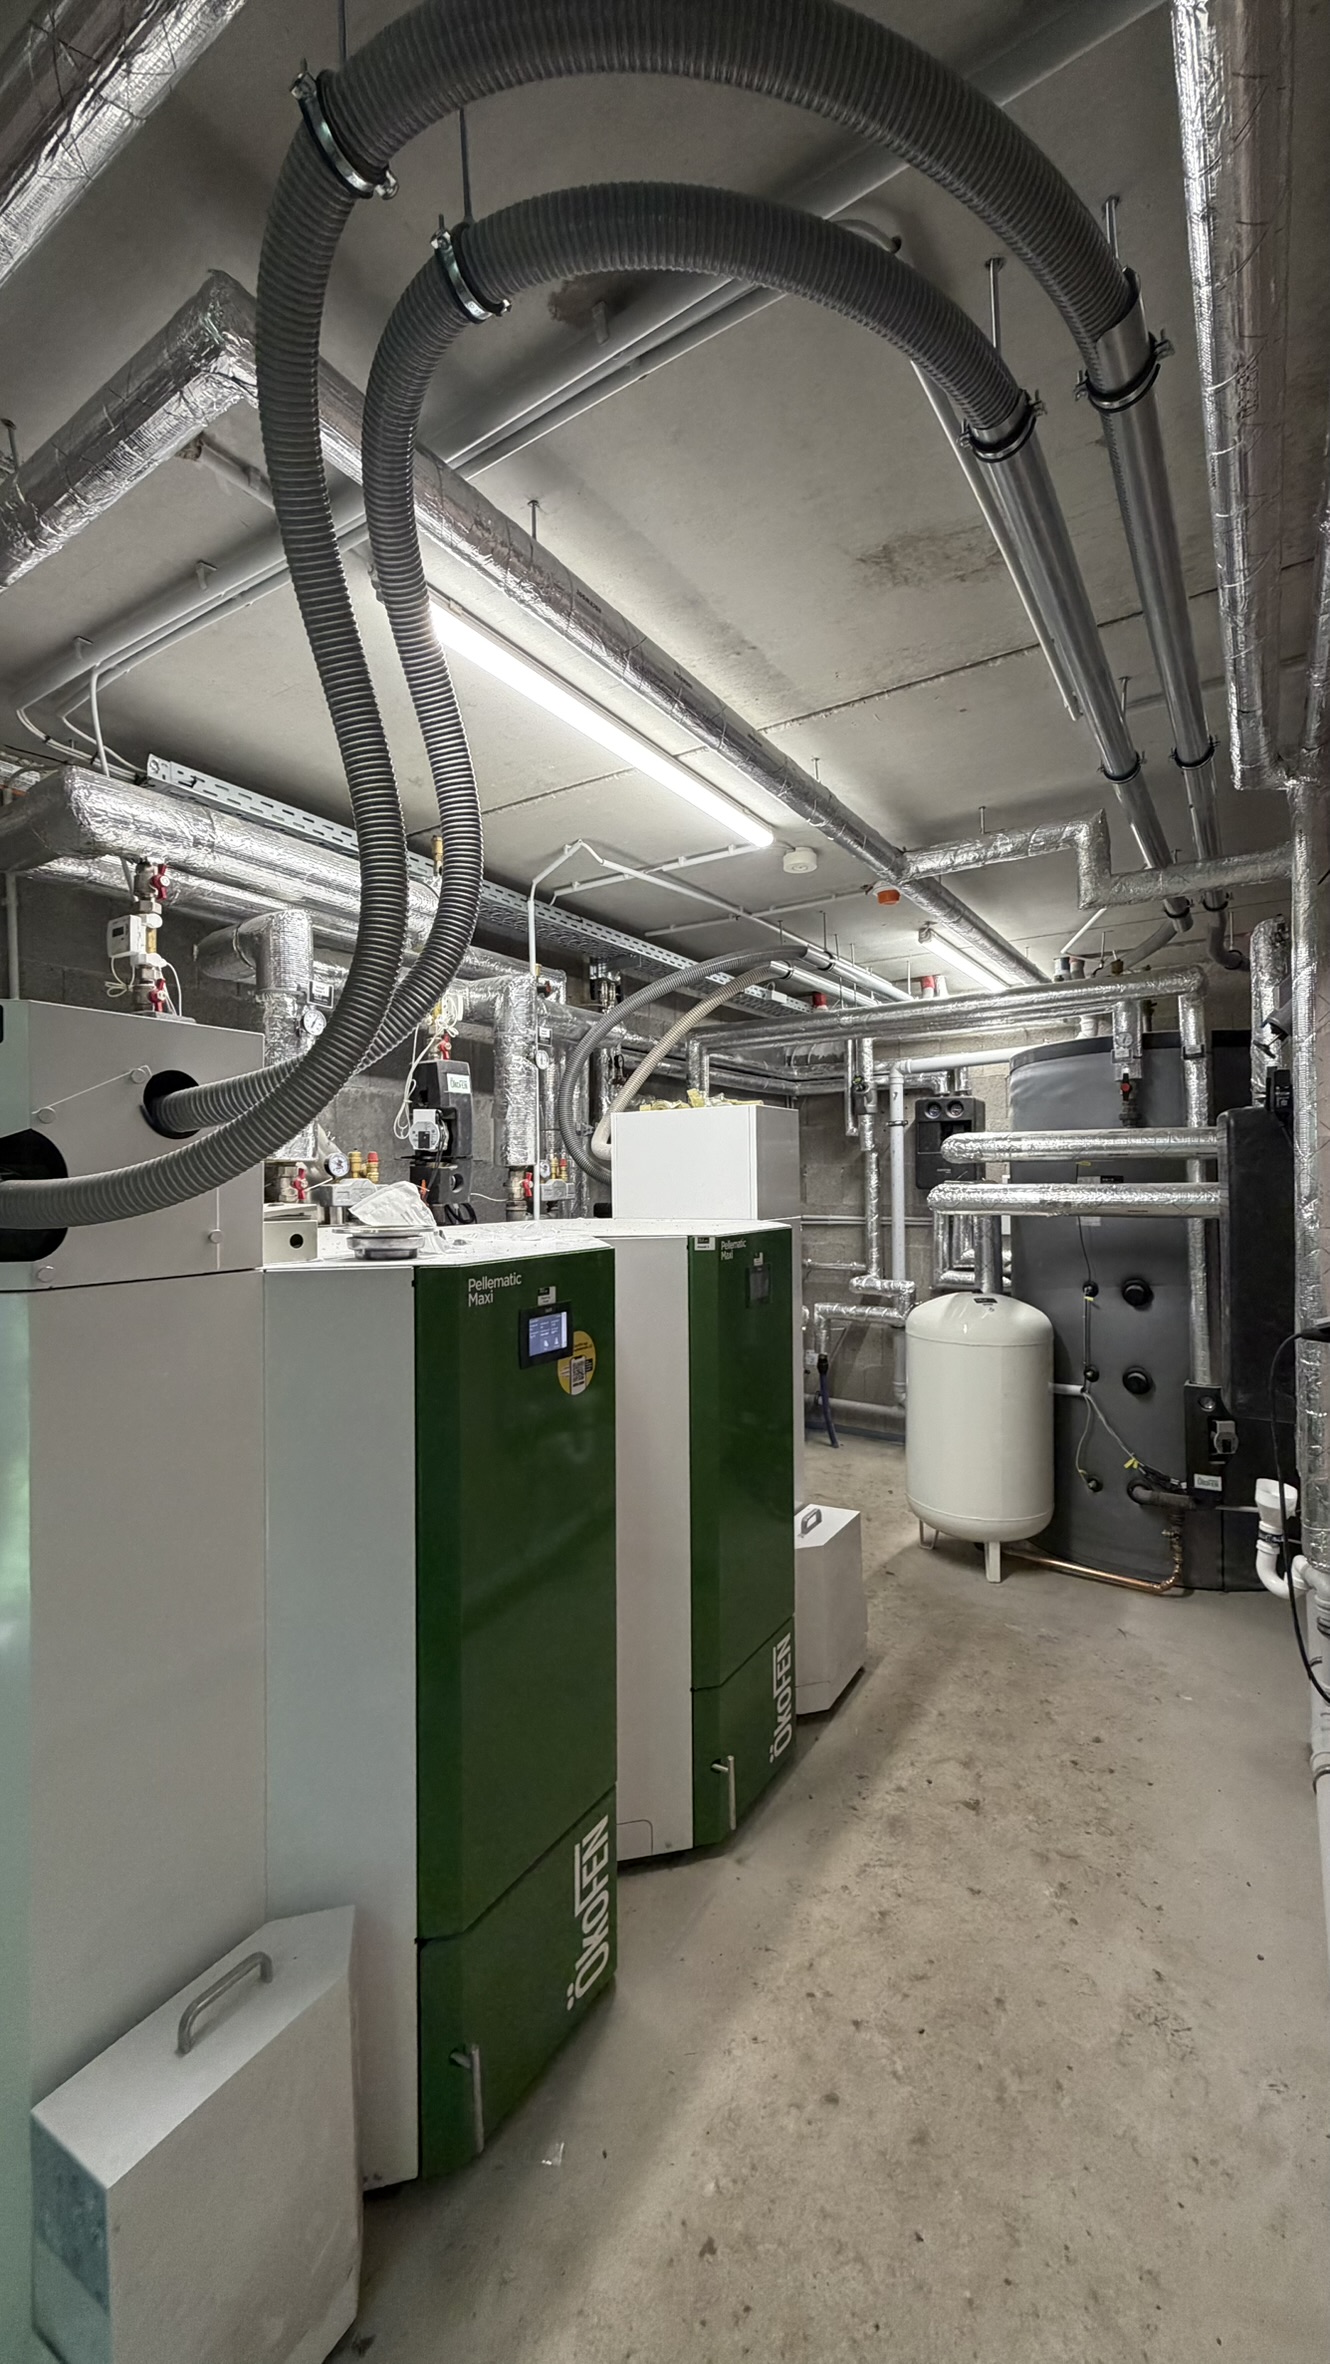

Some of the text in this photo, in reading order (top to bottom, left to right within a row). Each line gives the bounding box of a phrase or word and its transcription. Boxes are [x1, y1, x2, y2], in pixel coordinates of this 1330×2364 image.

[720, 1238, 747, 1251] Pellematic
[720, 1250, 734, 1260] Maxi
[468, 1272, 522, 1292] Pellematic
[468, 1290, 494, 1307] Maxi
[769, 1632, 792, 1763] ÖKOFEN
[566, 1814, 610, 2011] ÖKOFEN
